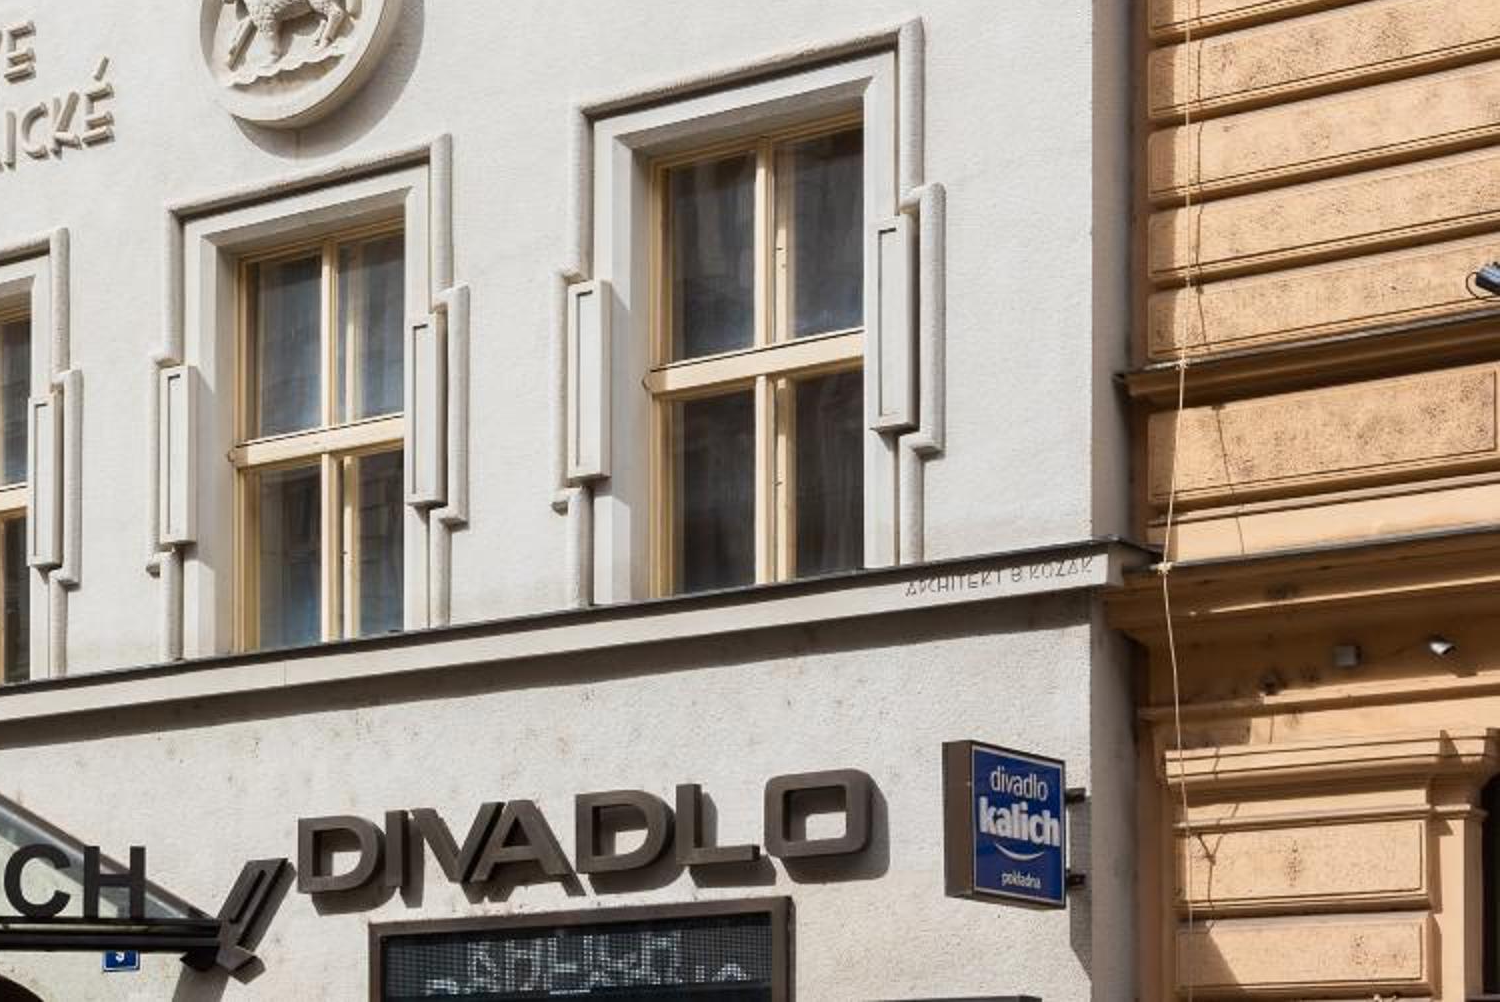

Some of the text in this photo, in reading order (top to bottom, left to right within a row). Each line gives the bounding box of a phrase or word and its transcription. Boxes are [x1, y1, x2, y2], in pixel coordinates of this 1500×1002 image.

[990, 766, 1049, 802] divadlo
[297, 768, 873, 897] DIVADLO
[979, 796, 1061, 847] kalich
[1001, 870, 1042, 890] pokladna
